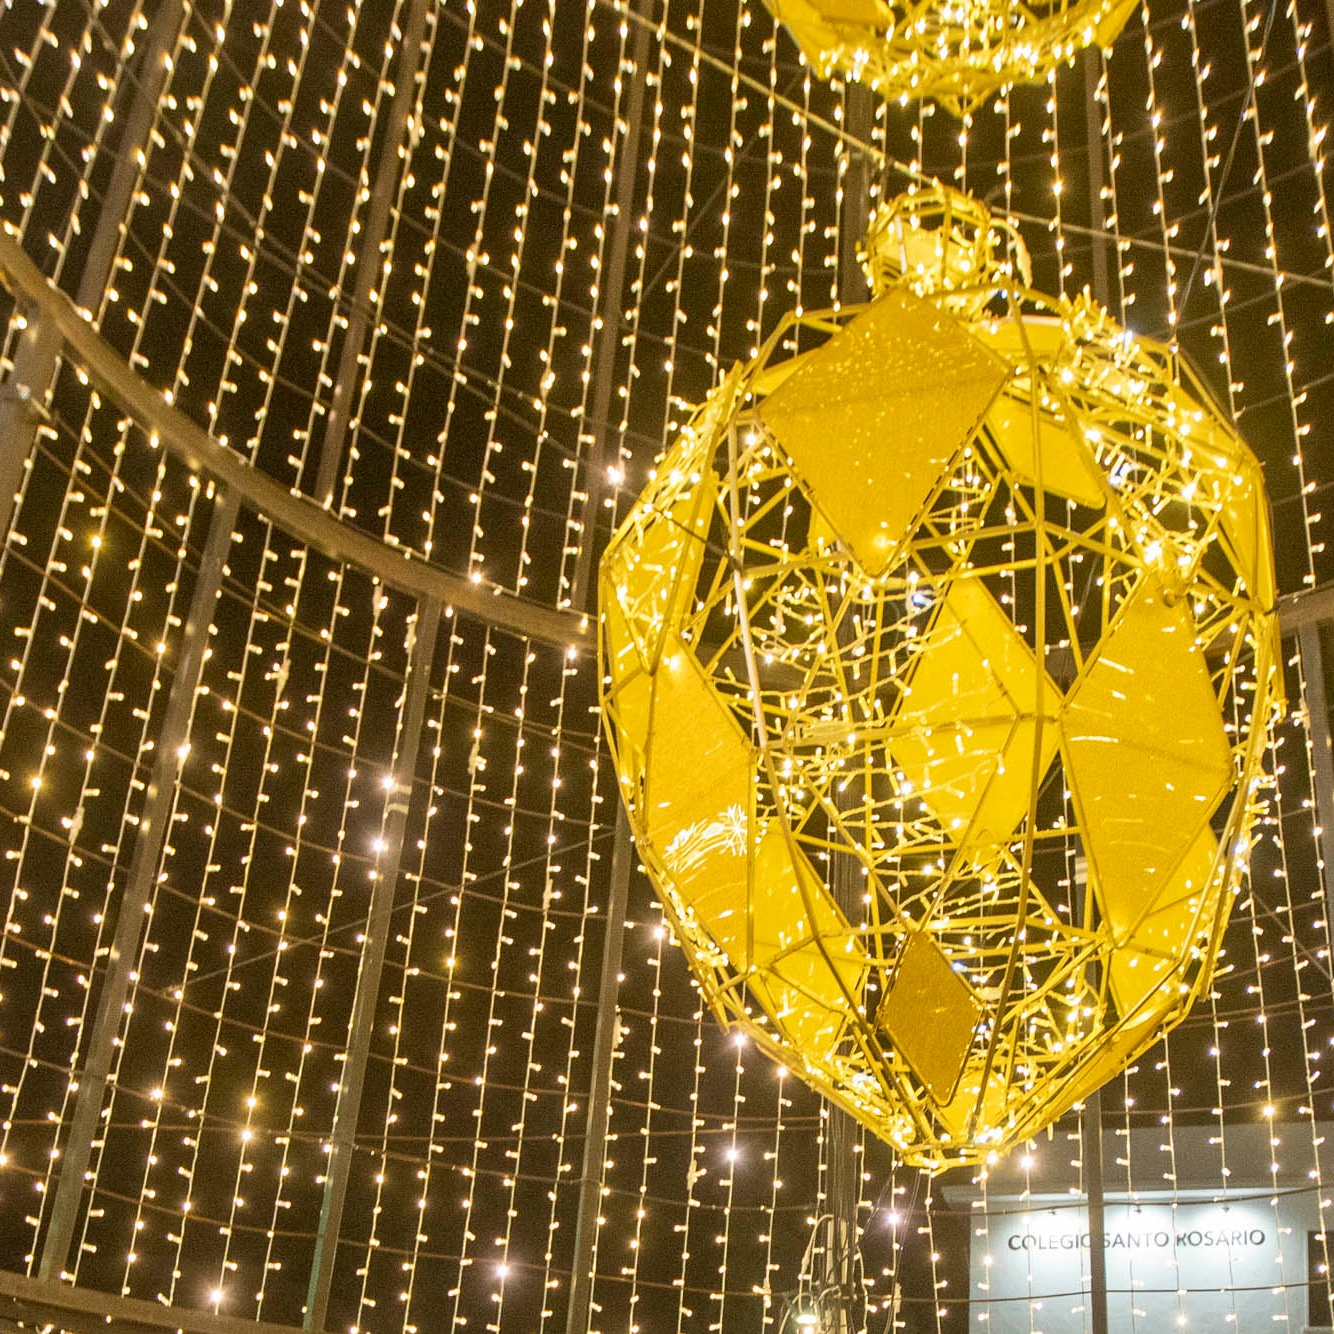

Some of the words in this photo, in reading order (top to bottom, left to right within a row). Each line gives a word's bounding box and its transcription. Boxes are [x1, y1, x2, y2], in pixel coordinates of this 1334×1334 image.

[1008, 1233, 1091, 1251] COLEGIO
[1102, 1231, 1170, 1249] SANTO
[1176, 1229, 1266, 1247] ROSARIO
